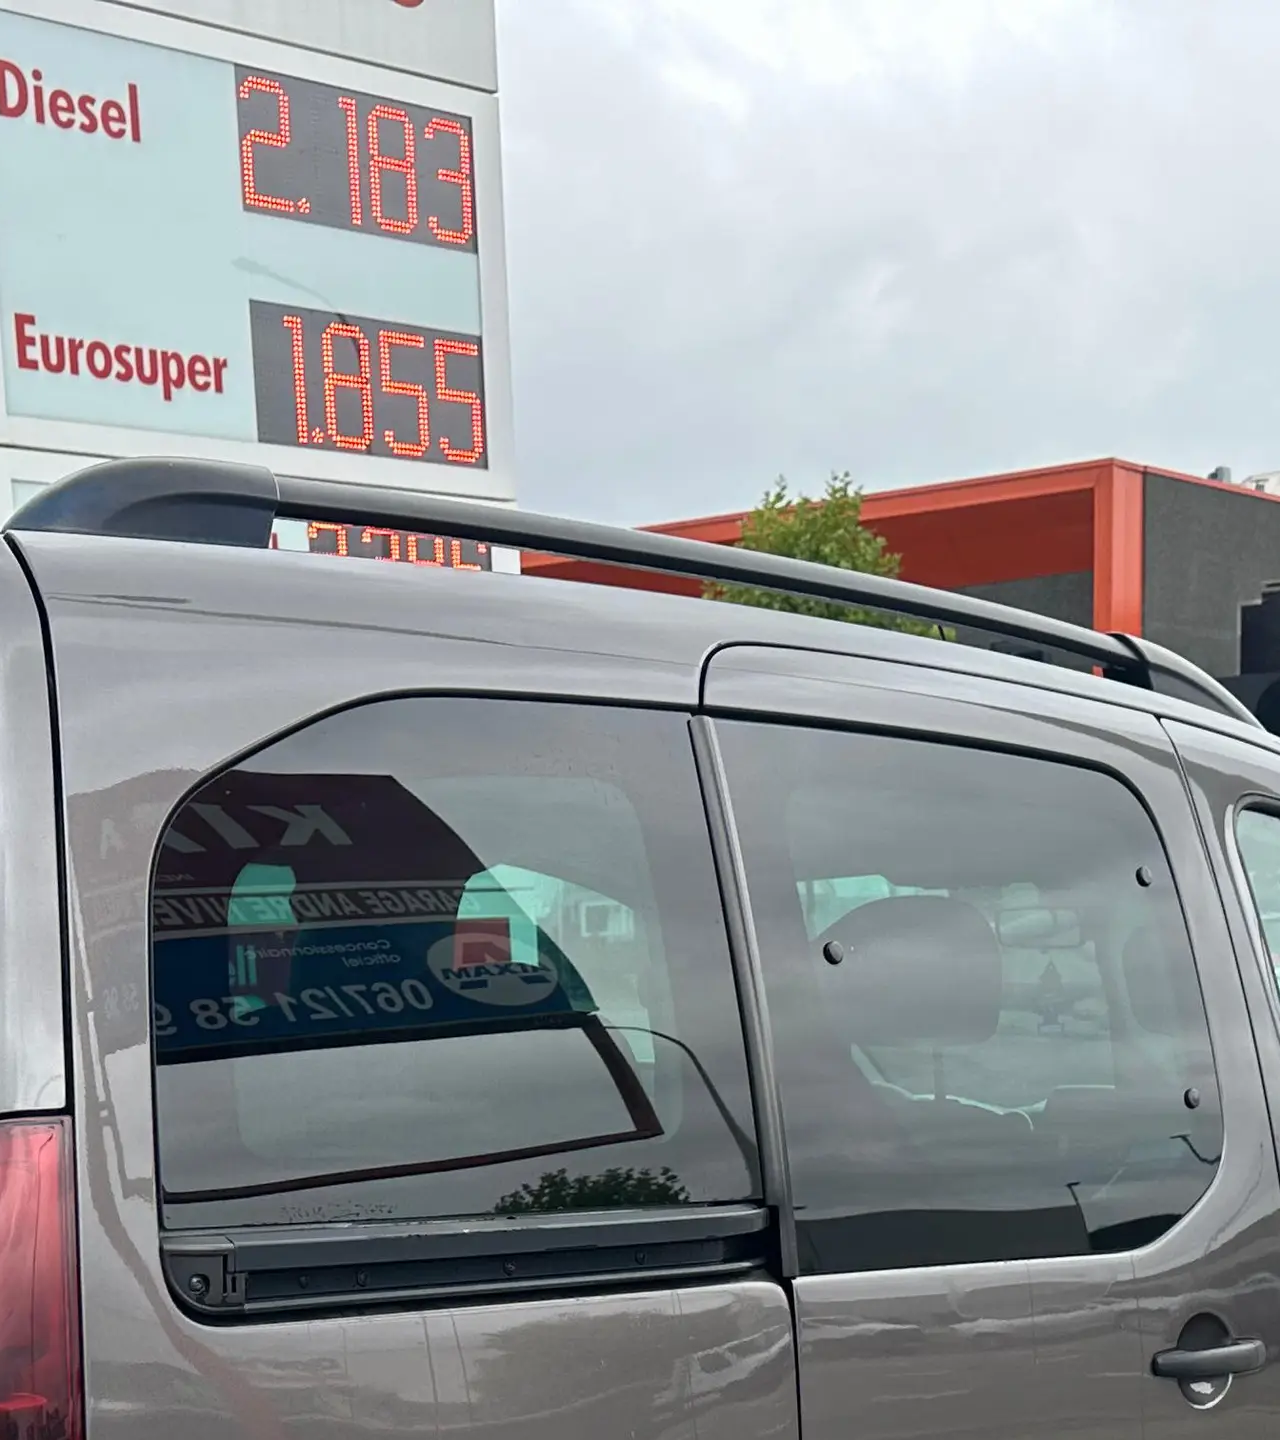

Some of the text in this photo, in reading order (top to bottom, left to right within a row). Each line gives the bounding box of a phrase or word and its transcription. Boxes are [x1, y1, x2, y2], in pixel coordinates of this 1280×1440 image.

[239, 75, 474, 246] 2.183
[13, 312, 484, 464] Eurosuper 1.855
